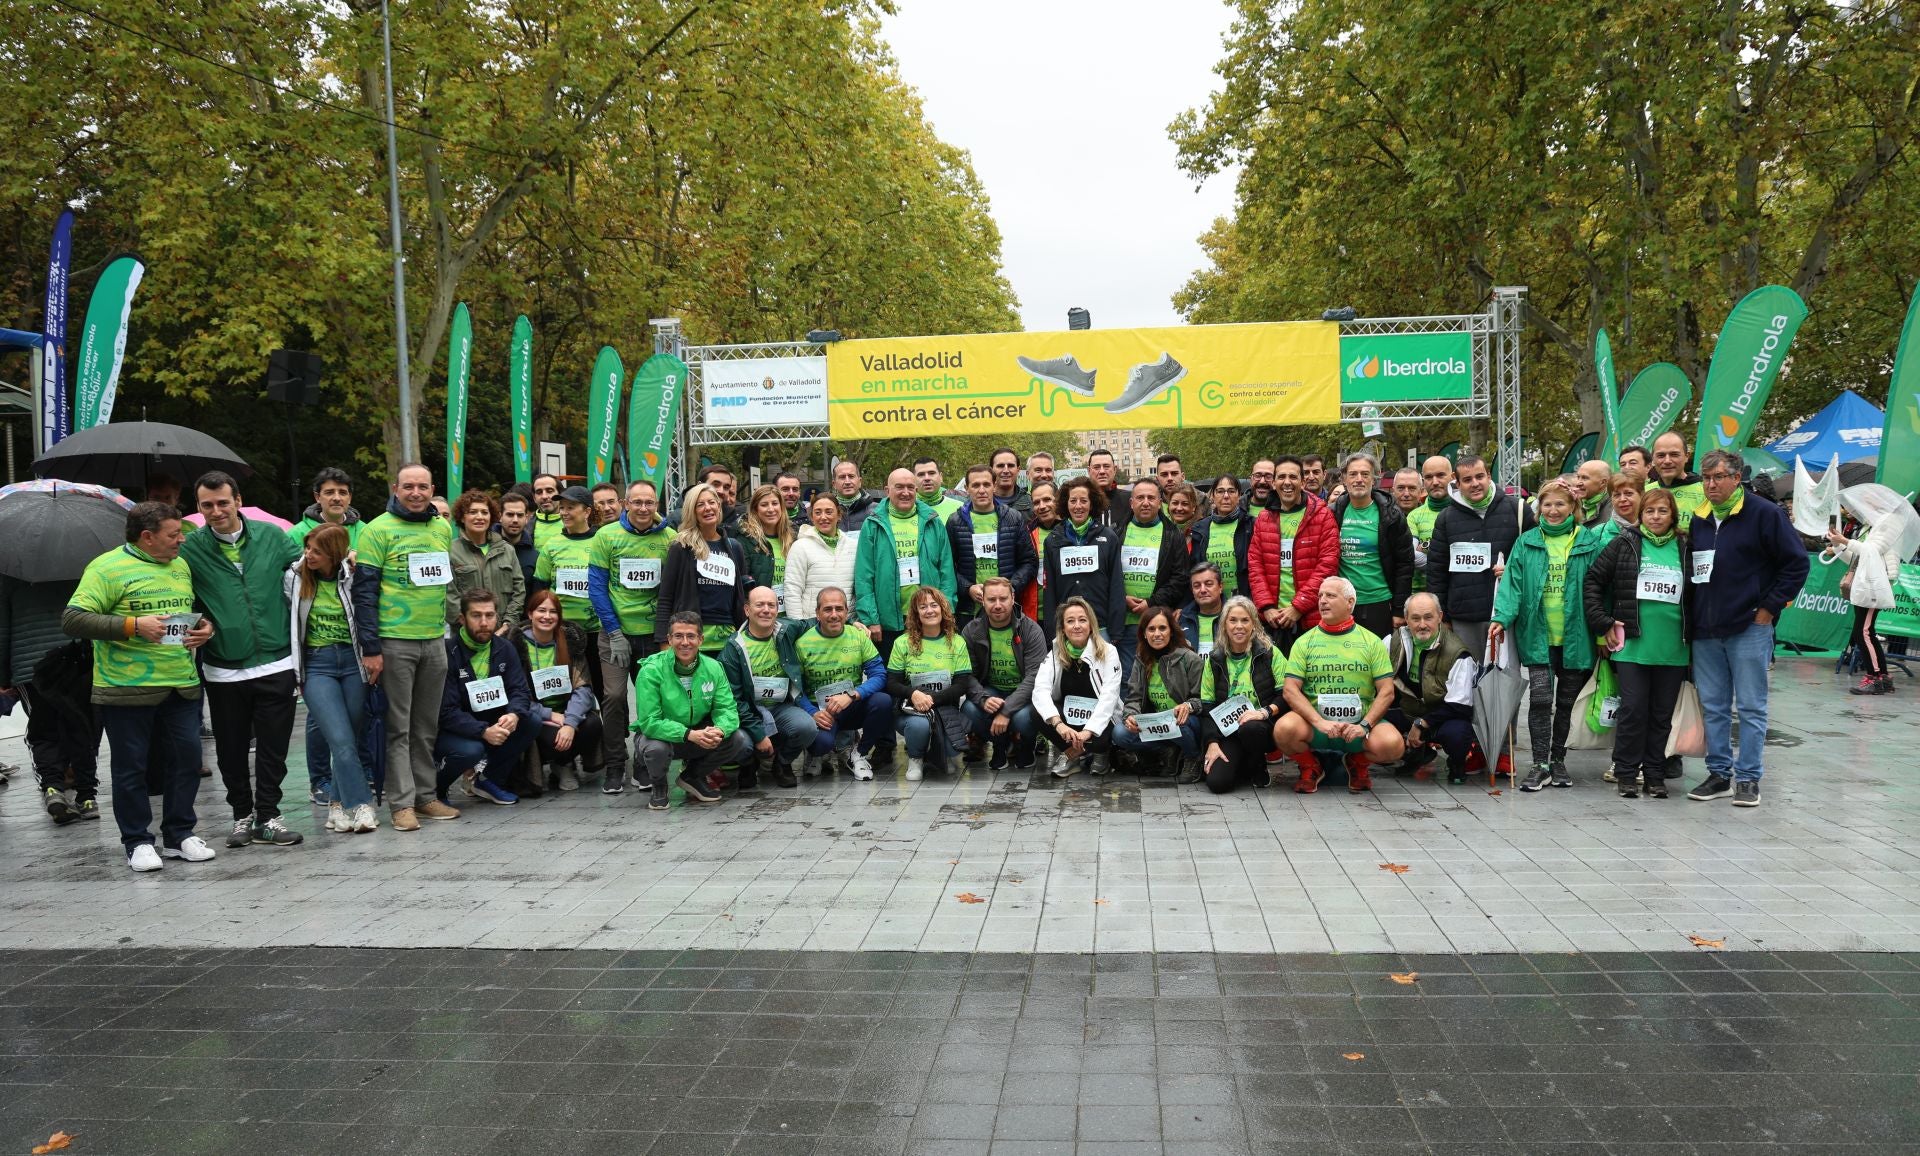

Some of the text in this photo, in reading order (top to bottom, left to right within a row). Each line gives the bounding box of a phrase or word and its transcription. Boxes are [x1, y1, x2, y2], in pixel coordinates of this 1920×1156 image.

[59, 267, 67, 322] Valladolid
[83, 323, 97, 376] española
[860, 351, 963, 372] Valladolid
[1383, 357, 1466, 377] Iberdrola
[1729, 315, 1788, 415] Iberdrola
[710, 381, 758, 390] Ayuntamiento
[788, 378, 821, 386] Valladolid
[861, 373, 968, 393] en marcha
[711, 396, 748, 407] FMD
[600, 372, 617, 457] Iberdrola
[648, 374, 677, 450] Iberdrola
[862, 402, 1026, 423] contra el cáncer
[1065, 556, 1094, 567] 39555
[1129, 556, 1149, 567] 1920
[1455, 554, 1485, 566] 57835
[420, 565, 442, 578] 1445
[627, 570, 655, 582] 42971
[703, 562, 730, 577] 42970
[908, 568, 913, 578] 1
[563, 580, 589, 591] 18102
[1644, 581, 1677, 595] 57854
[129, 600, 153, 611] En
[1794, 587, 1850, 615] Iberdrola
[1305, 660, 1369, 673] En marcha
[542, 677, 562, 691] 1939
[1307, 673, 1345, 683] contra
[762, 688, 774, 698] 20
[1319, 685, 1361, 695] cáncer
[1067, 707, 1092, 720] 5660
[1220, 704, 1250, 728] 33568
[1323, 706, 1356, 718] 48309
[1147, 723, 1170, 734] 1490
